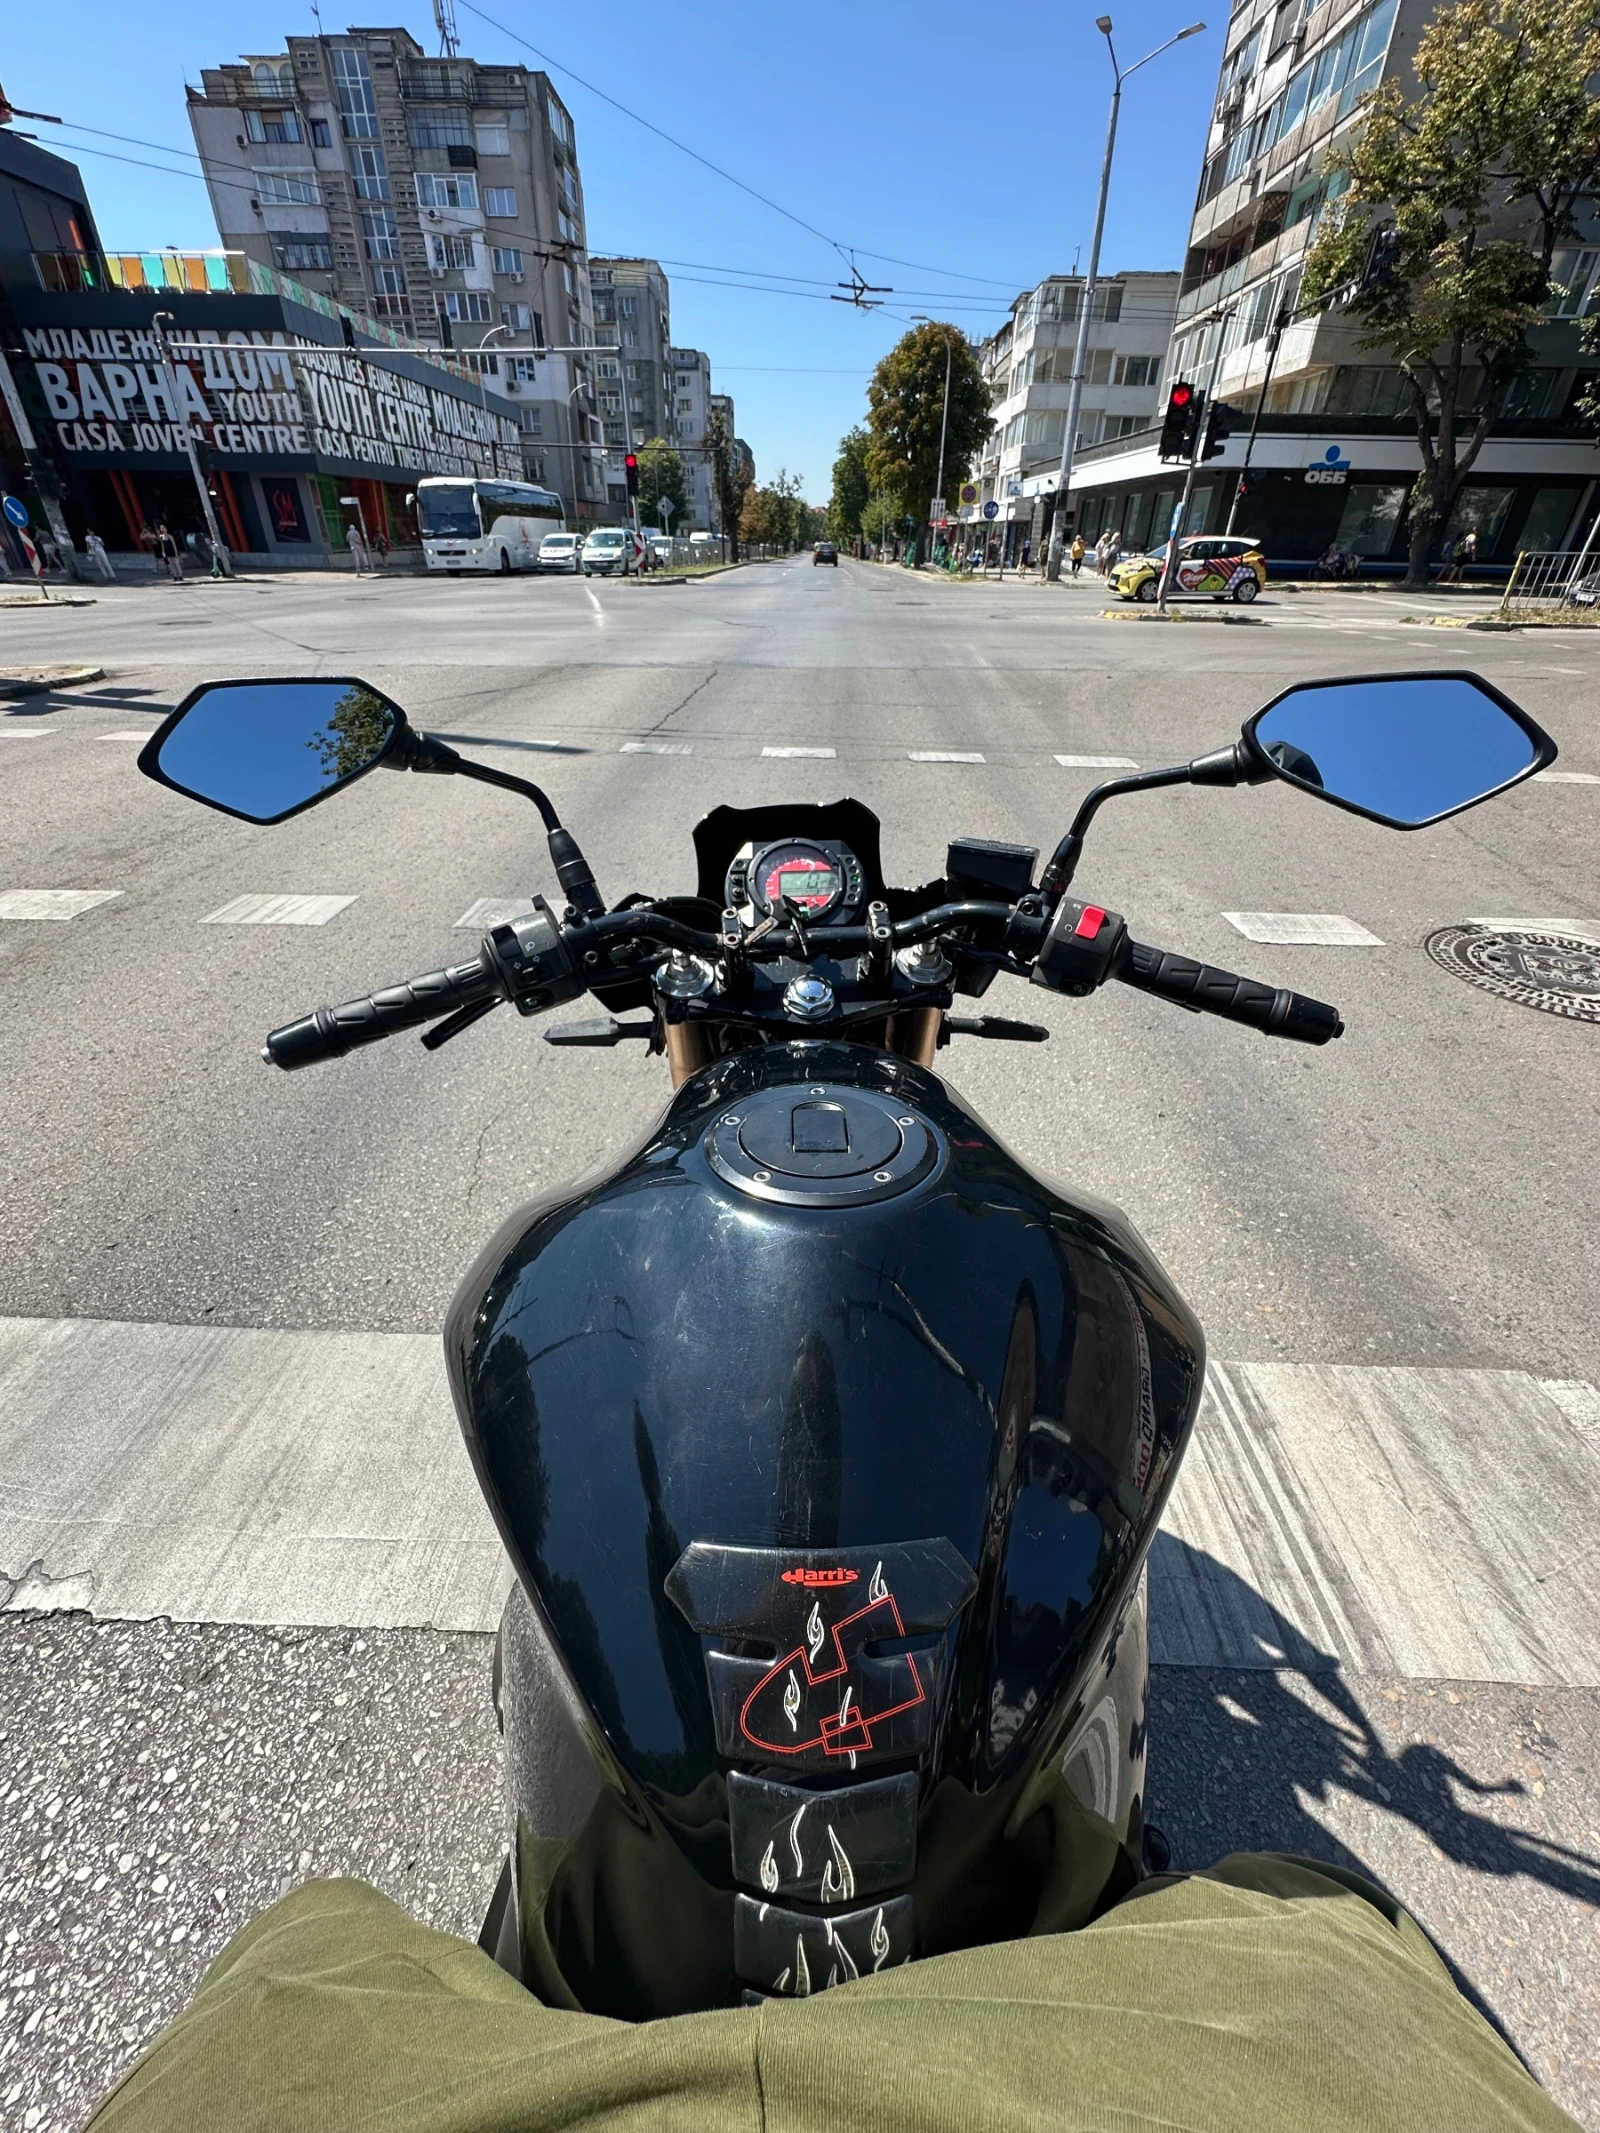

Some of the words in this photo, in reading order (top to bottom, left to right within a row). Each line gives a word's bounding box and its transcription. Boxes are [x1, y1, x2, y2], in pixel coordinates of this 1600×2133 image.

[198, 330, 296, 391] ДОМ
[294, 335, 343, 375] MAISON
[341, 355, 366, 386] DES
[365, 363, 401, 399] JEUNES
[34, 362, 213, 422] ВАРНА
[220, 392, 302, 423] YOUTH
[301, 367, 377, 439] YOUTH
[376, 393, 436, 450] CENTRE
[56, 421, 126, 452] CASA
[212, 423, 312, 454] CENTRE
[314, 427, 352, 460] CASA
[350, 434, 395, 467] PENTRU
[1304, 470, 1348, 485] ОББ
[781, 1567, 859, 1585] Harri's
